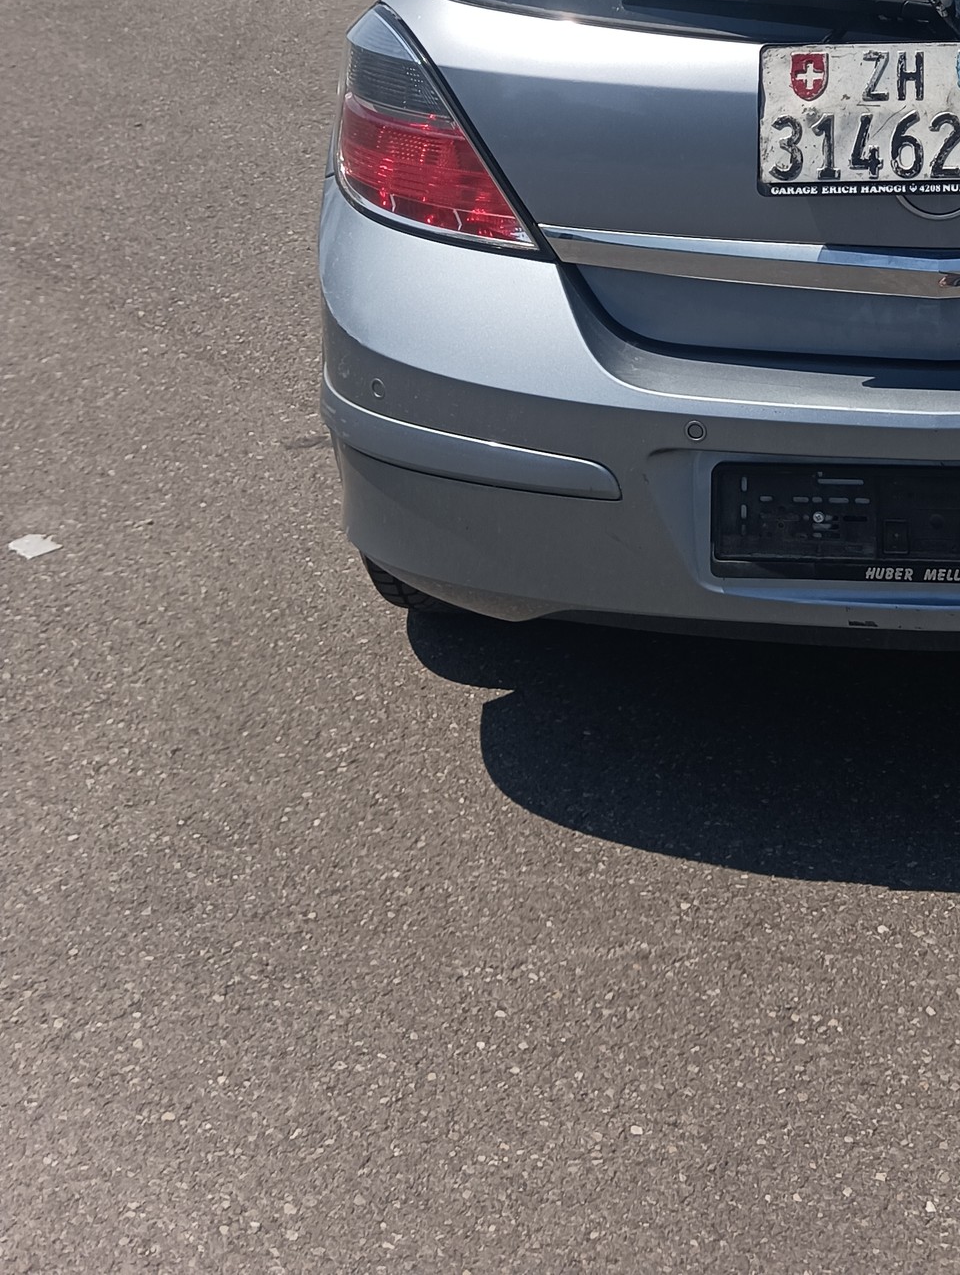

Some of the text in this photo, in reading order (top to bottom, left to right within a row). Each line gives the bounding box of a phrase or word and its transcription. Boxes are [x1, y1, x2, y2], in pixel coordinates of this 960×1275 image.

[862, 50, 924, 101] ZH
[771, 186, 818, 195] GARAGE
[821, 185, 857, 194] ERICH
[919, 184, 941, 192] 4208
[865, 567, 913, 581] HUBER
